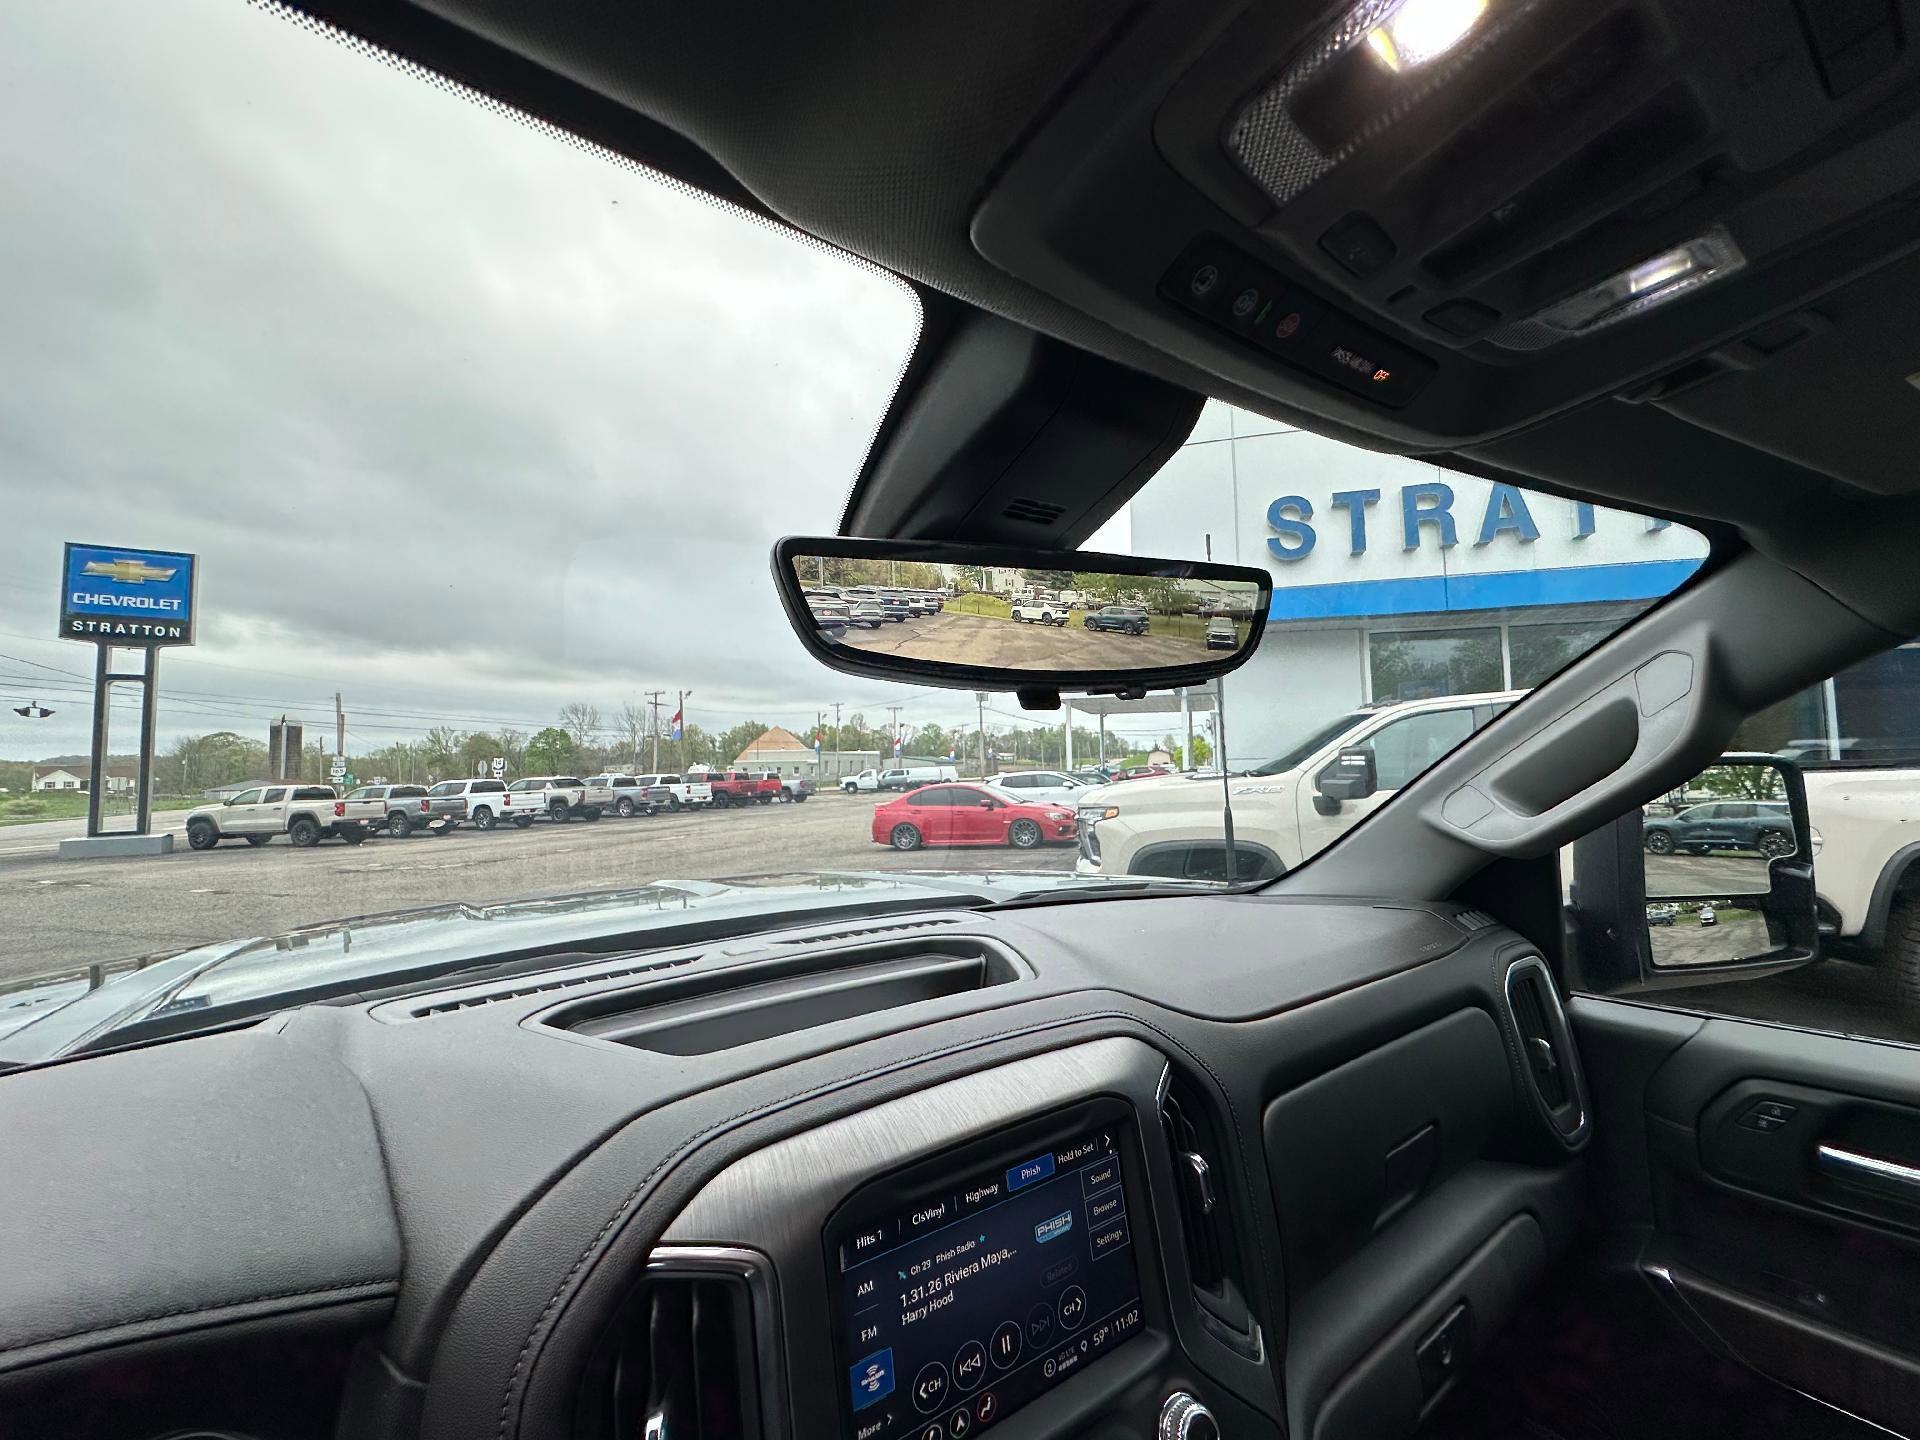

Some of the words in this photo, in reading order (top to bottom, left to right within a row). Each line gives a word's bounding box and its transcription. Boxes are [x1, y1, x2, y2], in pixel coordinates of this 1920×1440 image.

[1267, 482, 1672, 561] STRA
[72, 592, 181, 611] CHEVROLET
[72, 620, 181, 638] STRATTON
[1058, 1150, 1074, 1164] Hold
[1074, 1149, 1082, 1158] to
[1082, 1143, 1094, 1154] Set
[1021, 1164, 1041, 1180] Phish
[1090, 1168, 1112, 1185] Sound
[965, 1184, 999, 1203] Highway
[912, 1203, 945, 1225] ClsVinyl
[1093, 1199, 1117, 1216] Browse
[1037, 1213, 1071, 1237] PHISH
[856, 1235, 876, 1249] Hits
[877, 1230, 883, 1240] 1
[1096, 1229, 1122, 1248] Settings
[910, 1265, 921, 1276] Ch
[921, 1259, 931, 1271] 29
[936, 1249, 956, 1264] Phish
[956, 1240, 976, 1255] Radio
[857, 1280, 874, 1296] AM
[900, 1278, 942, 1307] 1.31.26
[944, 1263, 979, 1287] Riviera
[901, 1306, 928, 1326] Harry
[929, 1290, 954, 1312] Hood
[1063, 1302, 1075, 1315] CH
[1115, 1310, 1139, 1332] 11:02
[860, 1326, 877, 1342] FM
[928, 1377, 942, 1392] CH
[857, 1421, 881, 1440] More
